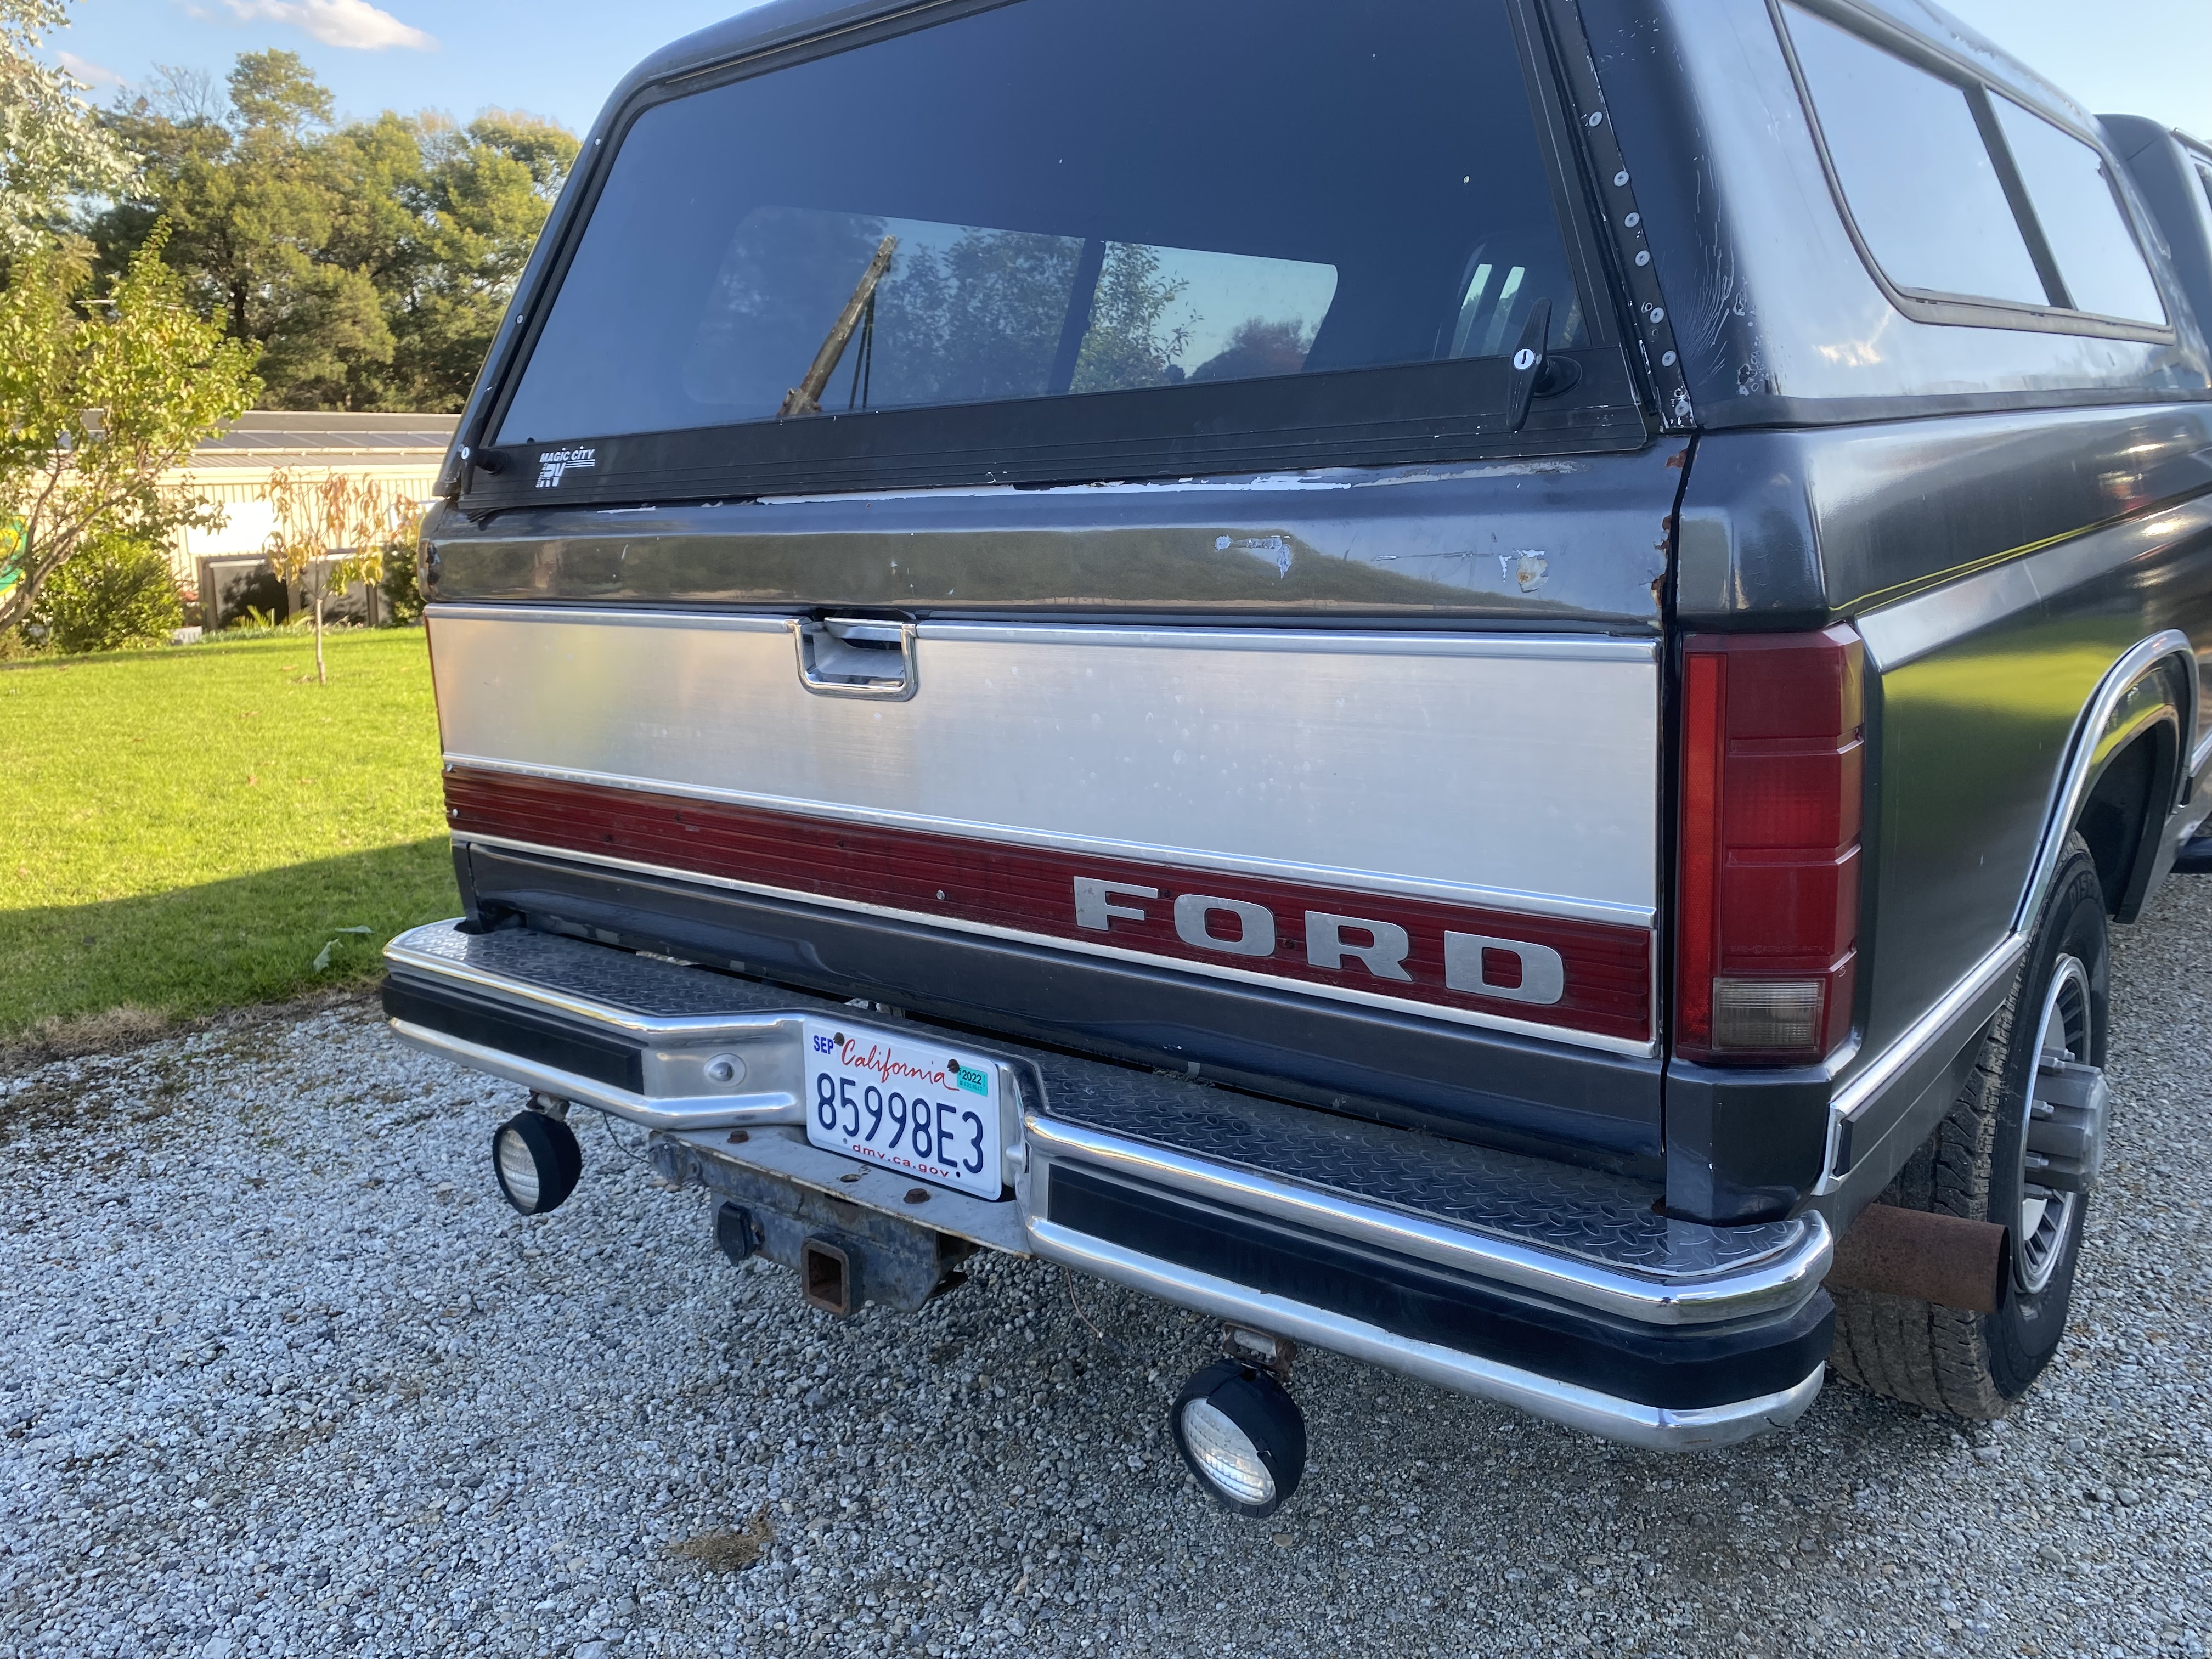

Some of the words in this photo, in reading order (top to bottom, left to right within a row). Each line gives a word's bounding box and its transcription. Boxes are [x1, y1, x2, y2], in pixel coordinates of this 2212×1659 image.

[539, 447, 571, 462] MAGIC
[571, 445, 595, 461] CITY
[1074, 876, 1564, 1005] FORD
[813, 1035, 834, 1054] SEP
[841, 1039, 960, 1091] California
[962, 1070, 982, 1085] 2022
[816, 1073, 984, 1174] 85998E3
[852, 1143, 950, 1178] dmv.ca.gov
